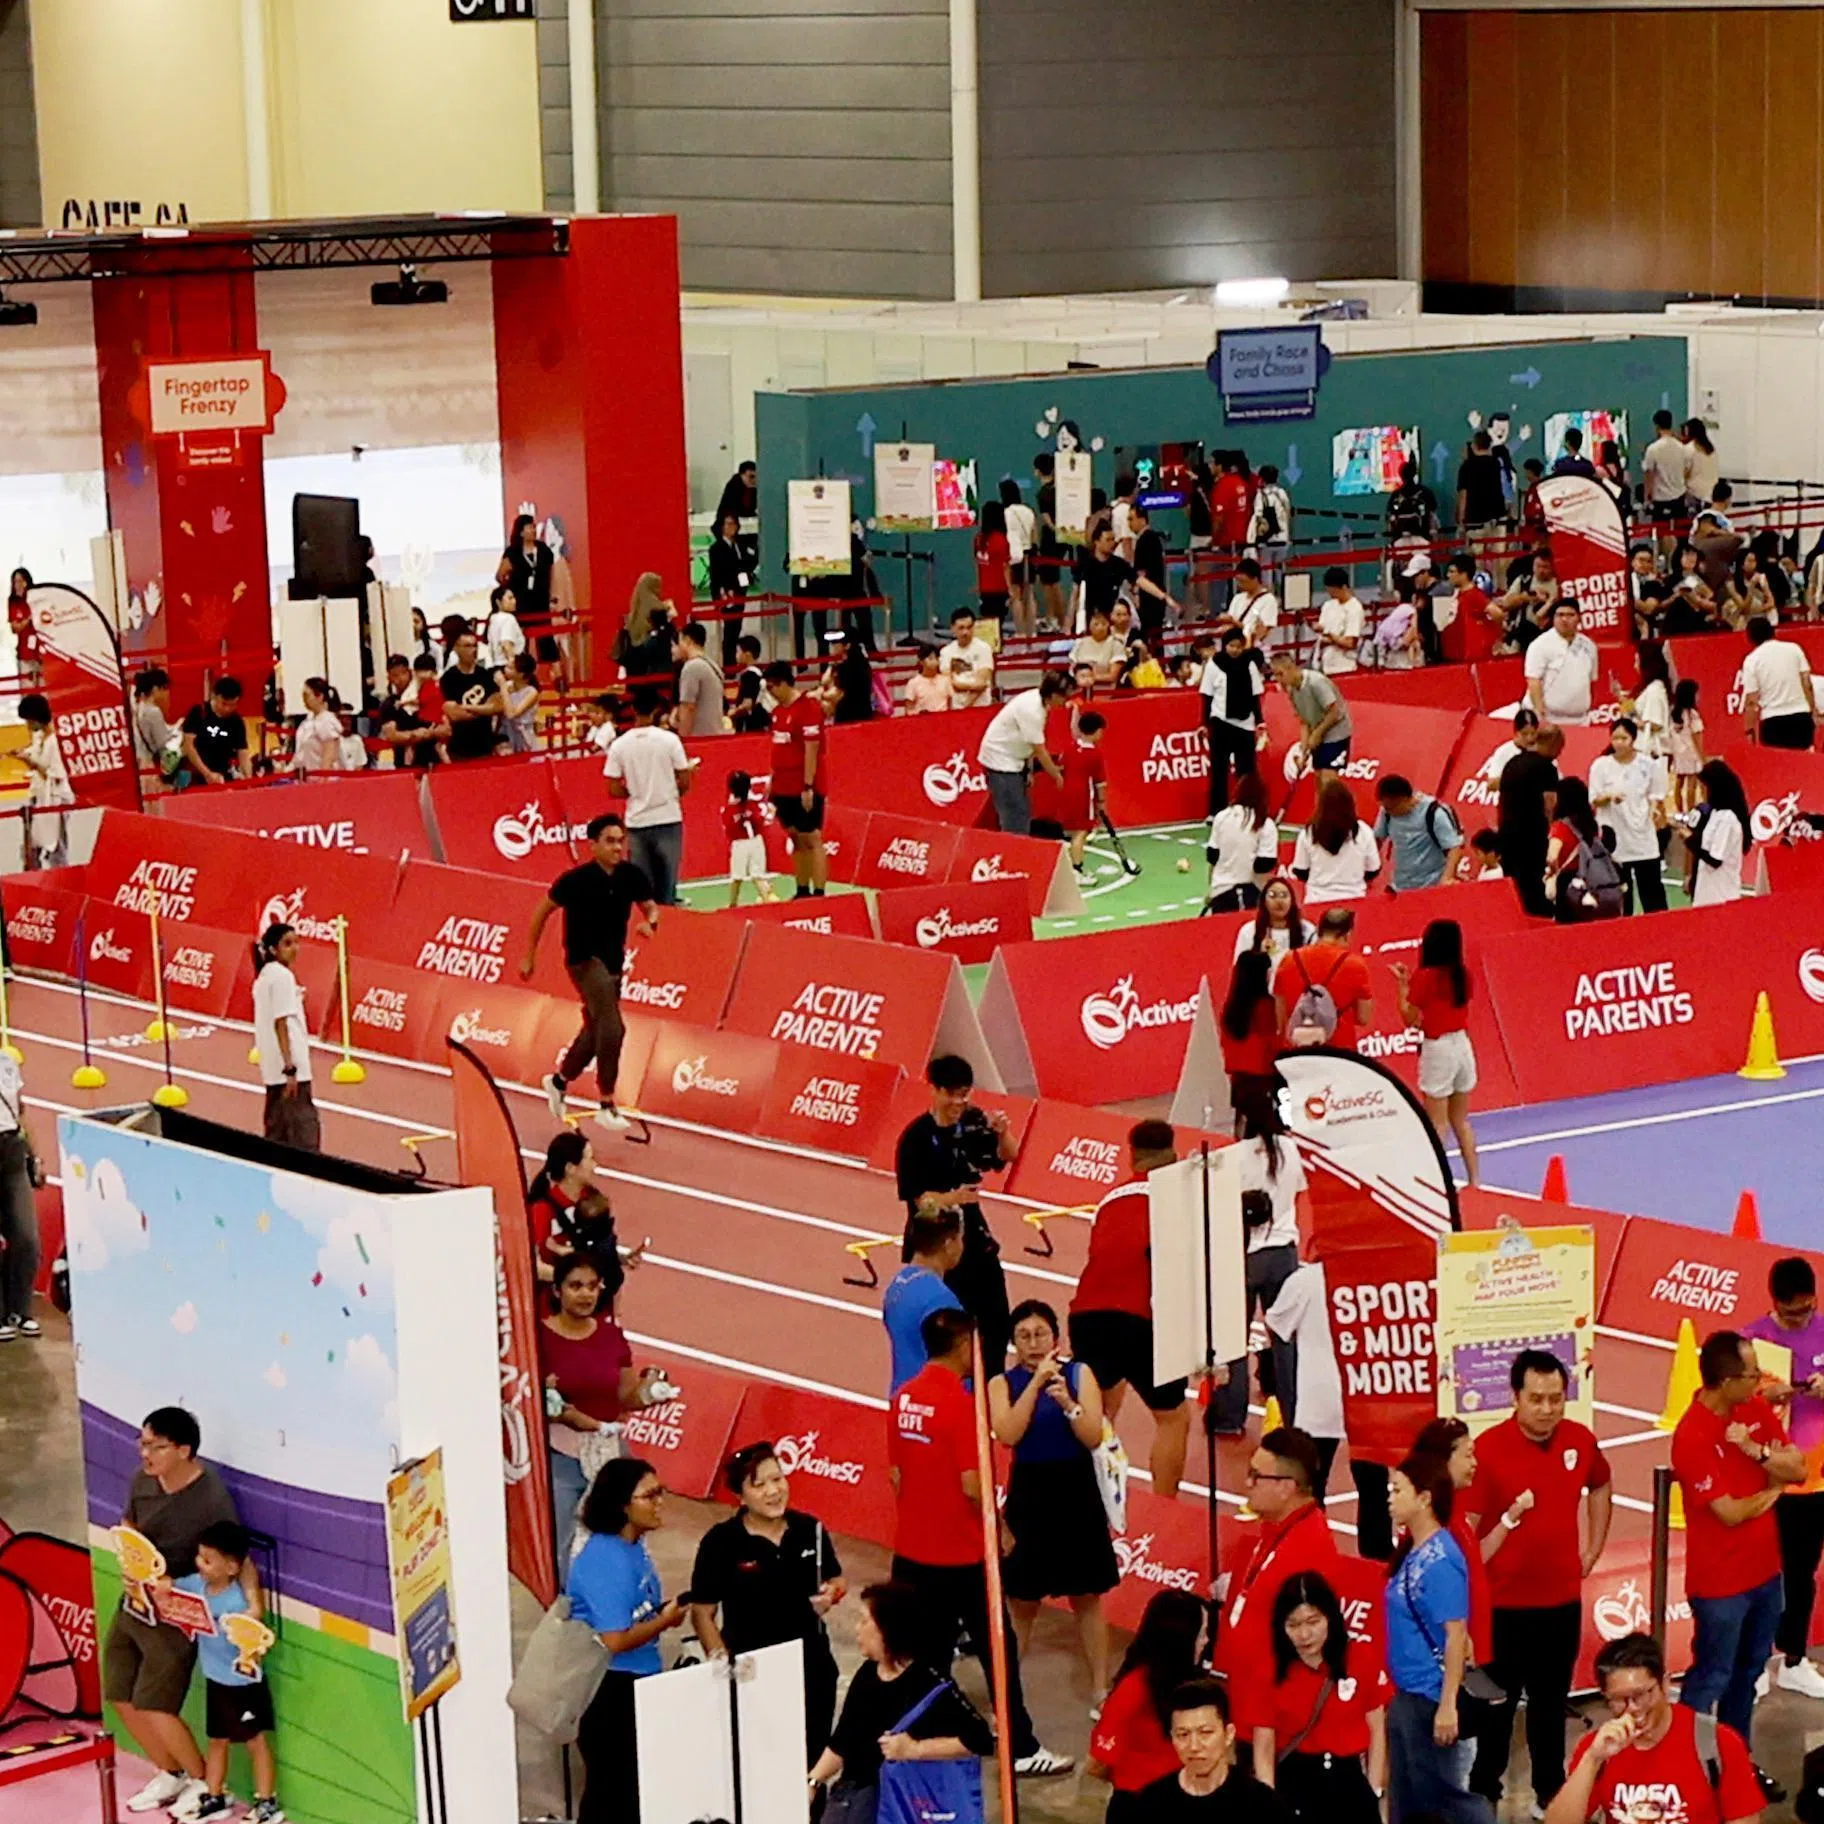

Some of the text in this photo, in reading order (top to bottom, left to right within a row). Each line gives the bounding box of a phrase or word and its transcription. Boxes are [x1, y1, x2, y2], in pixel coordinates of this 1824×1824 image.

[1230, 345, 1308, 362] Family Race
[1234, 363, 1304, 379] and Chase
[164, 376, 250, 400] Fingertap
[180, 396, 237, 417] Frenzy
[1562, 571, 1626, 598] SPORT
[57, 705, 126, 735] SPORT
[66, 749, 126, 775] MORE
[878, 853, 928, 877] PARENTS
[889, 838, 929, 862] ACTIVE
[130, 859, 198, 894] ACTIVE
[15, 905, 57, 929] ACTIVE
[115, 886, 196, 921] PARENTS
[6, 921, 56, 946] PARENTS
[437, 917, 511, 953] ACTIVE
[940, 915, 999, 940] ActiveSG
[173, 947, 214, 972] ACTIVE
[418, 943, 504, 984] PARENTS
[164, 962, 212, 989] PARENTS
[1574, 961, 1676, 1005] ACTIVE
[364, 987, 407, 1014] ACTIVE
[795, 983, 884, 1026] ACTIVE
[353, 1004, 406, 1034] PARENTS
[1565, 993, 1695, 1040] PARENTS
[773, 1009, 881, 1058] PARENTS
[807, 1076, 860, 1104] ACTIVE
[1326, 1088, 1384, 1112] ActiveSG
[792, 1094, 859, 1126] PARENTS
[1065, 1136, 1120, 1164] ACTIVE
[1051, 1151, 1118, 1184] PARENTS
[1667, 1259, 1739, 1292] ACTIVE
[1650, 1280, 1737, 1315] PARENTS
[1339, 1319, 1437, 1355] & MUC
[1347, 1357, 1430, 1397] MORE
[798, 1450, 862, 1485] ActiveSG
[1132, 1556, 1196, 1592] ActiveSG
